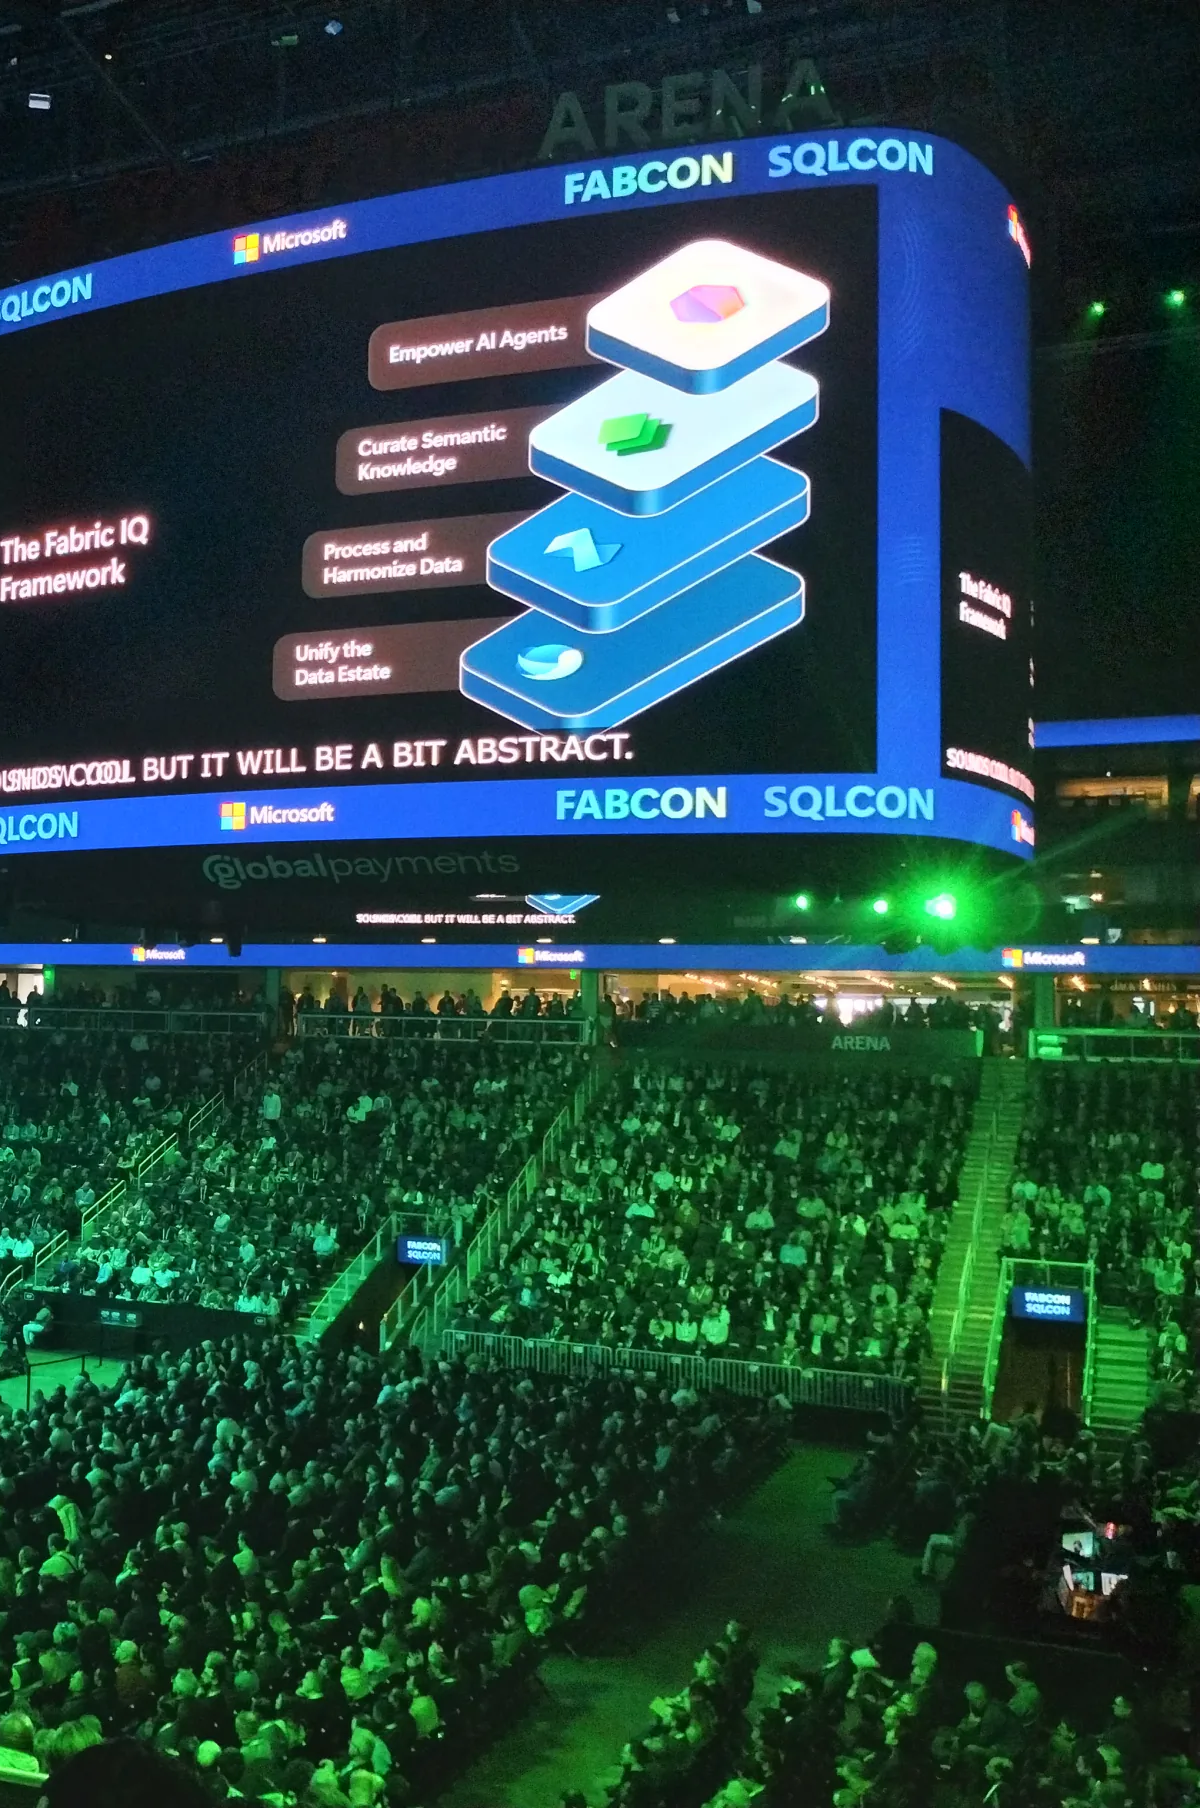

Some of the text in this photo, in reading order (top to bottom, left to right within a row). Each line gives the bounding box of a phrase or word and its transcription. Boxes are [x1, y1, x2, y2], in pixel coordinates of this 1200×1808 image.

[537, 59, 844, 158] ARENA
[565, 138, 933, 204] FABCON SQLCON
[264, 218, 347, 253] Microsoft
[389, 326, 568, 363] Empower AI Agents
[358, 423, 507, 456] Curate Semantic
[358, 454, 457, 481] Knowledge
[0, 515, 149, 564] The Fabric IQ
[324, 532, 429, 560] Process and
[0, 557, 126, 602] Framework
[323, 557, 464, 584] Harmonize Data
[295, 640, 373, 663] Unify the
[295, 664, 392, 686] Data Estate
[142, 755, 194, 782] BUT
[201, 752, 229, 778] IT
[237, 747, 306, 776] WILL
[315, 744, 353, 771] BE
[361, 744, 383, 769] A
[393, 739, 447, 768] BIT
[453, 733, 634, 766] ABSTRACT.
[250, 801, 334, 825] Microsoft
[556, 786, 727, 821] FABCON
[764, 785, 934, 821] SQLCON
[424, 914, 443, 924] BUT
[444, 914, 456, 924] IT
[458, 914, 481, 924] WILL
[496, 914, 504, 924] A
[145, 948, 186, 961] Microsoft
[535, 950, 585, 963] Microsoft
[1023, 951, 1086, 967] Microsoft
[831, 1035, 891, 1051] ARENA
[1025, 1303, 1070, 1315] SQLCON
